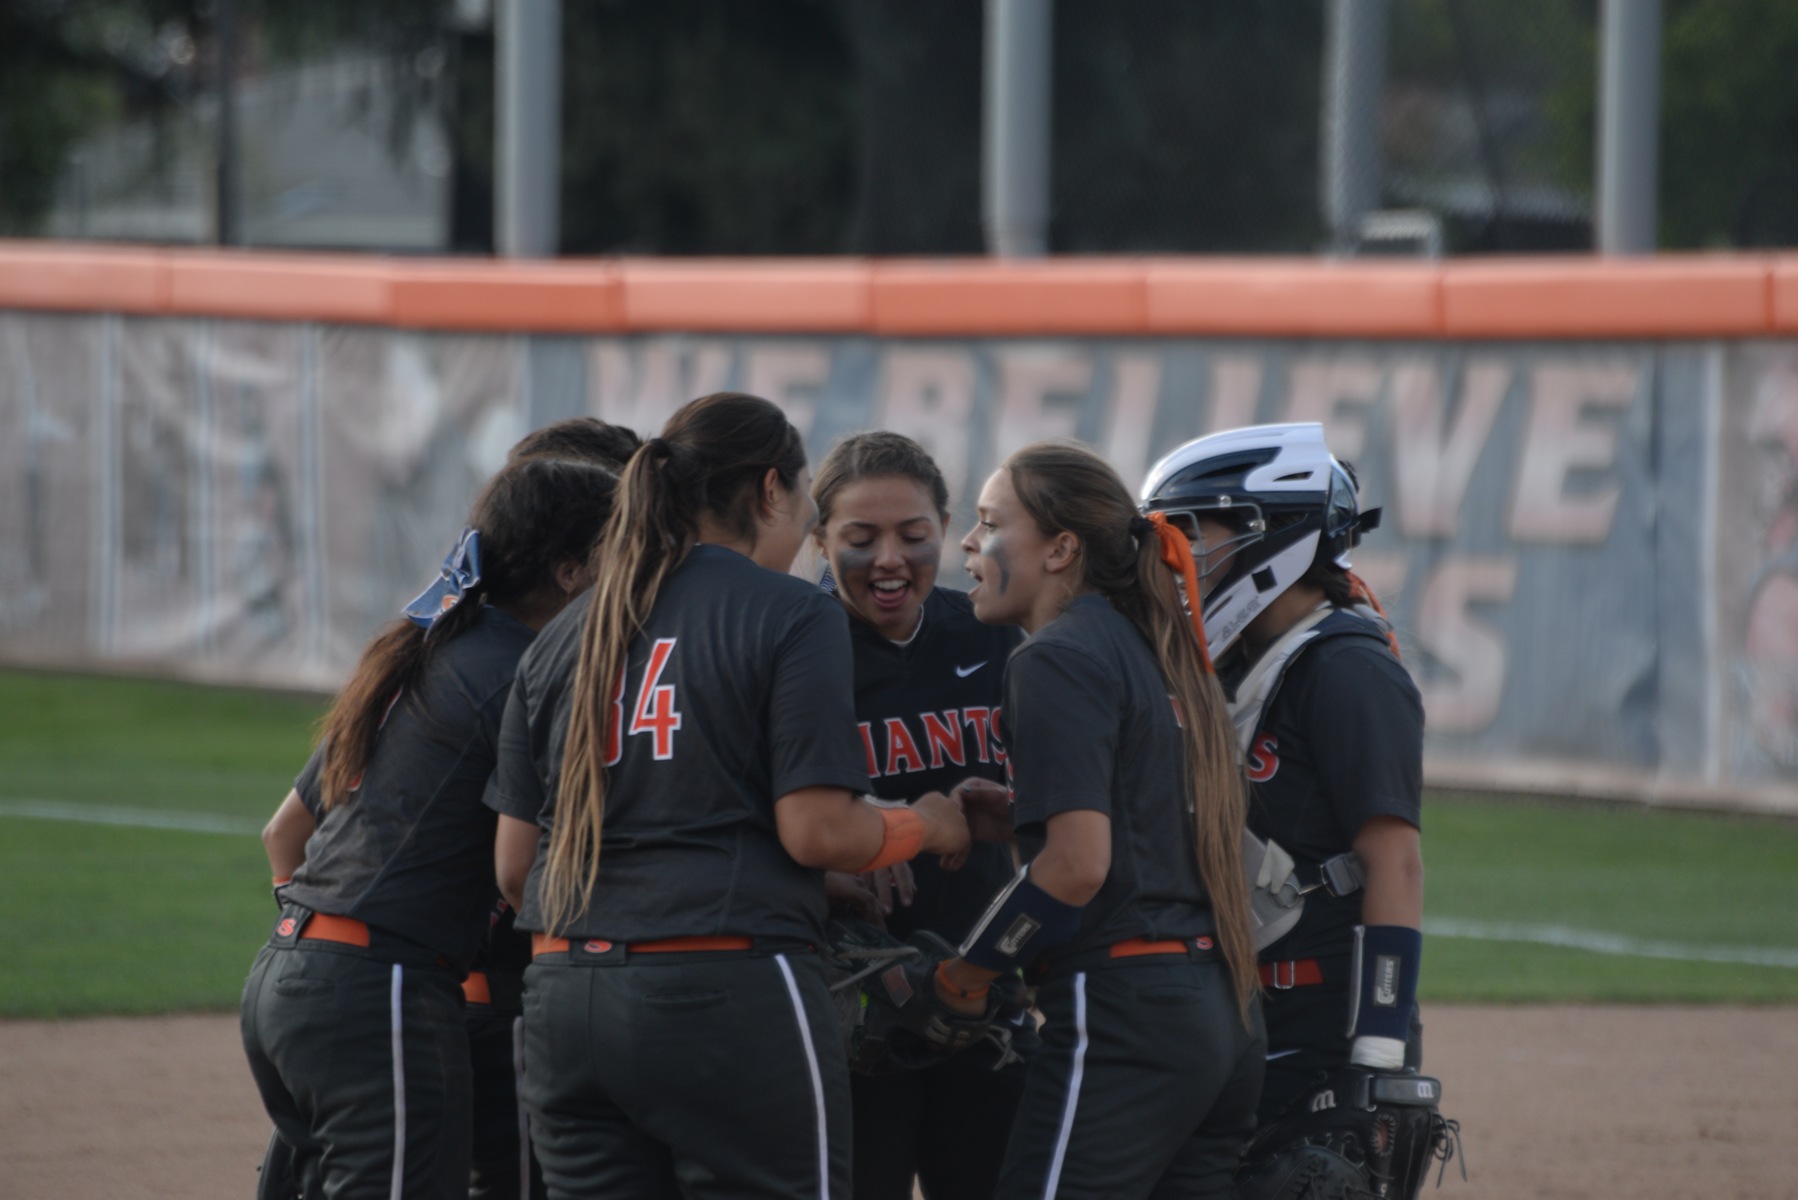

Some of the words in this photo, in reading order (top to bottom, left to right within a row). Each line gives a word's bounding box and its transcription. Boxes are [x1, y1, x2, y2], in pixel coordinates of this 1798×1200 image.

[857, 706, 1006, 779] IANTS
[1000, 921, 1032, 954] CUTTERS
[1376, 959, 1394, 1004] CUTTERS
